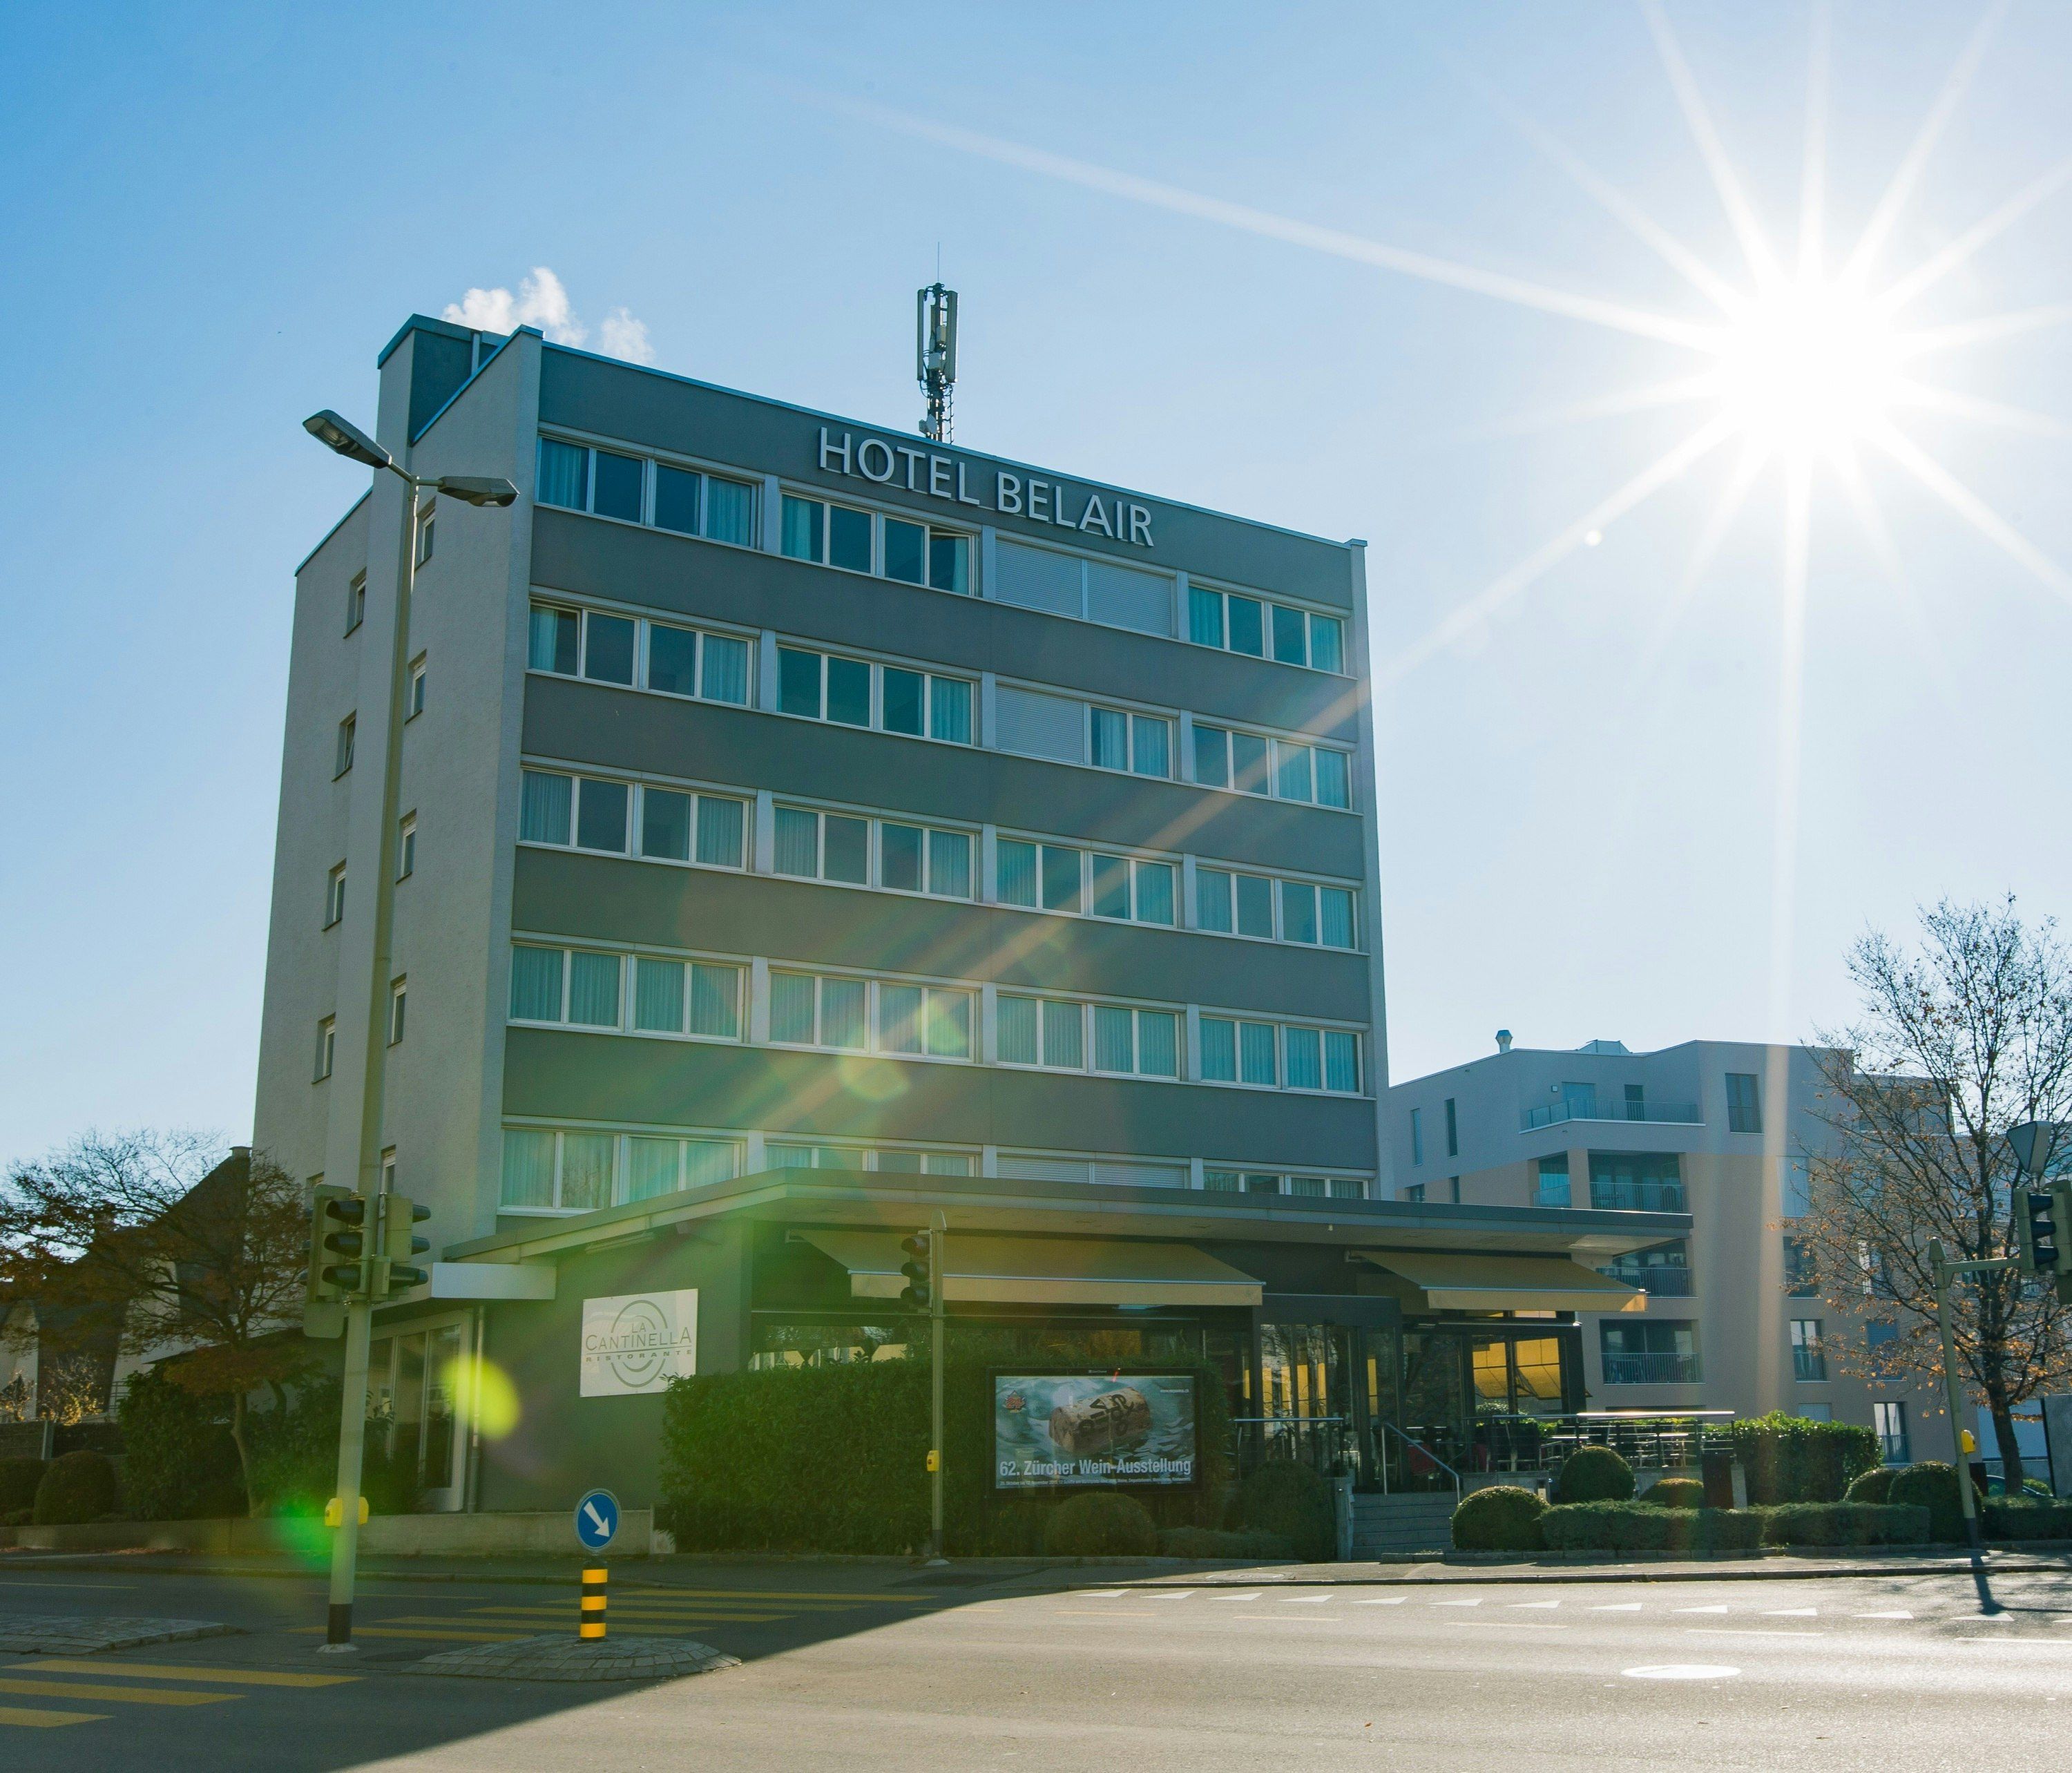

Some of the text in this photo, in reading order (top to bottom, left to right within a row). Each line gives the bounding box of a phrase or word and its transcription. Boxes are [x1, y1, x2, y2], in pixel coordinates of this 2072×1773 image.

[818, 426, 1155, 547] HOTEL BELAIR
[631, 1322, 646, 1333] LA
[586, 1326, 692, 1351] CANTINELLA
[586, 1350, 692, 1362] RISTORANTE
[999, 1458, 1191, 1476] 62. Zürcher Wein-Ausstellung
